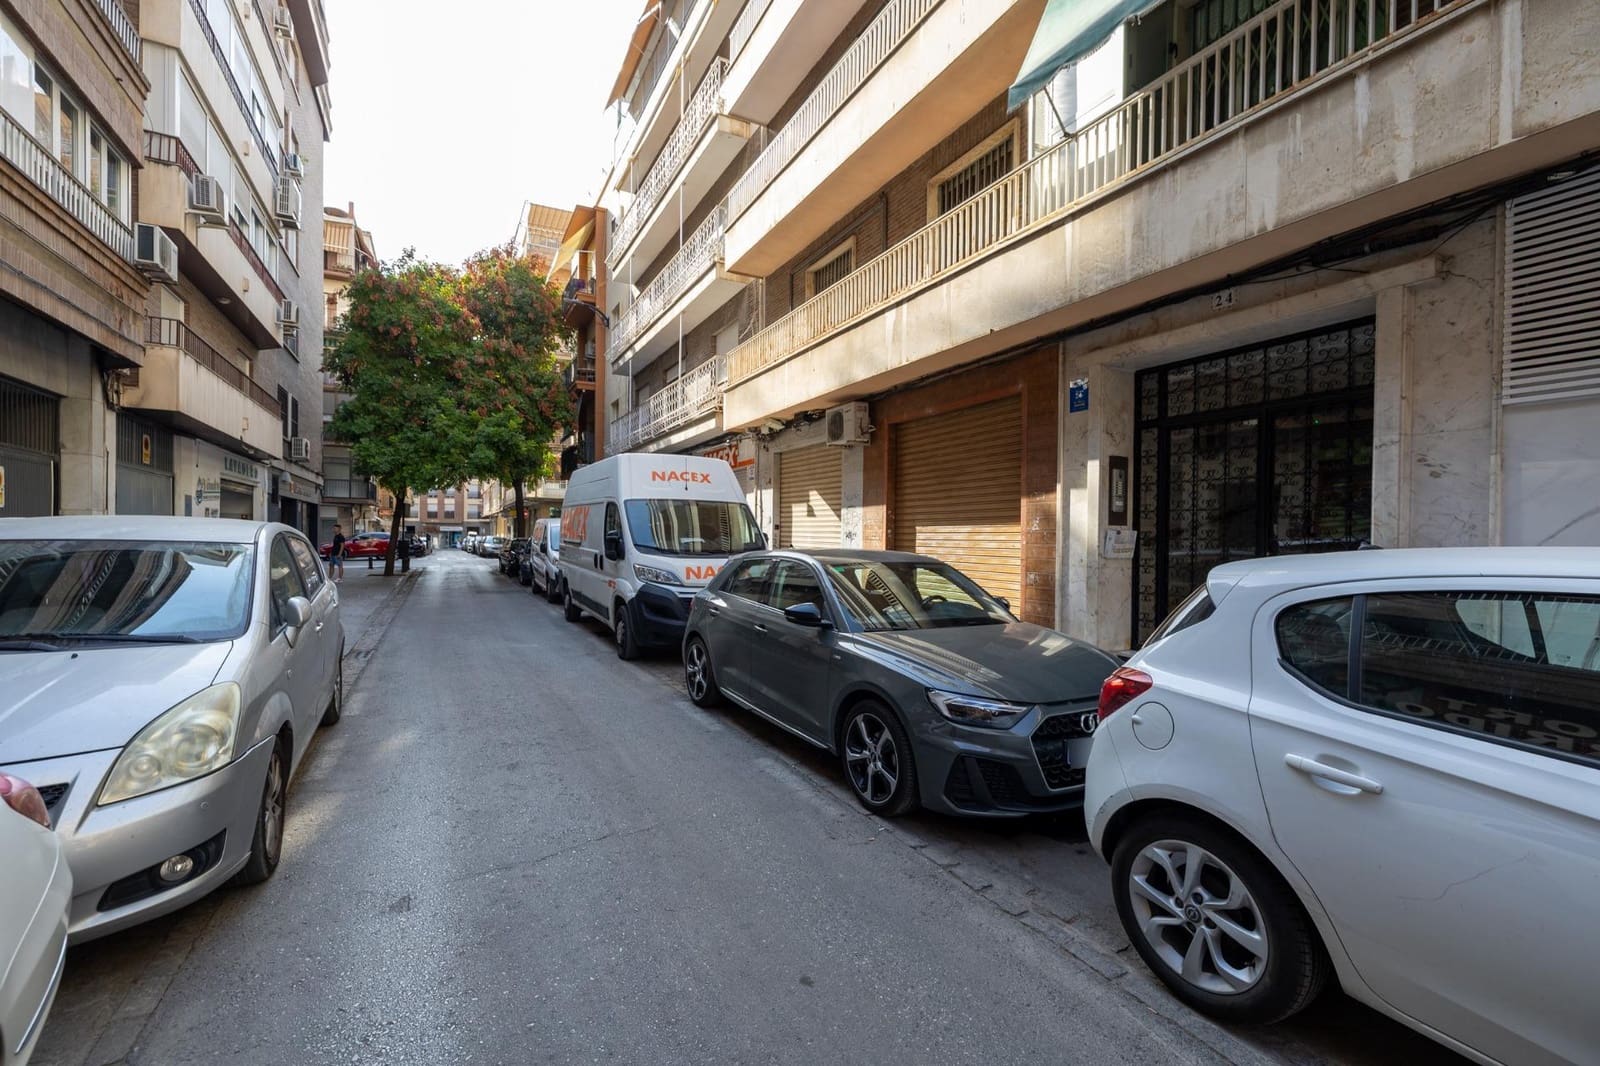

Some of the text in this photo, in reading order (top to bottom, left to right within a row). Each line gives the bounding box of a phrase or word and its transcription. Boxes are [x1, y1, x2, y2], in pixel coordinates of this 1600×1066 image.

[1216, 293, 1233, 307] 24
[651, 471, 711, 484] NACEX
[685, 565, 724, 580] NA
